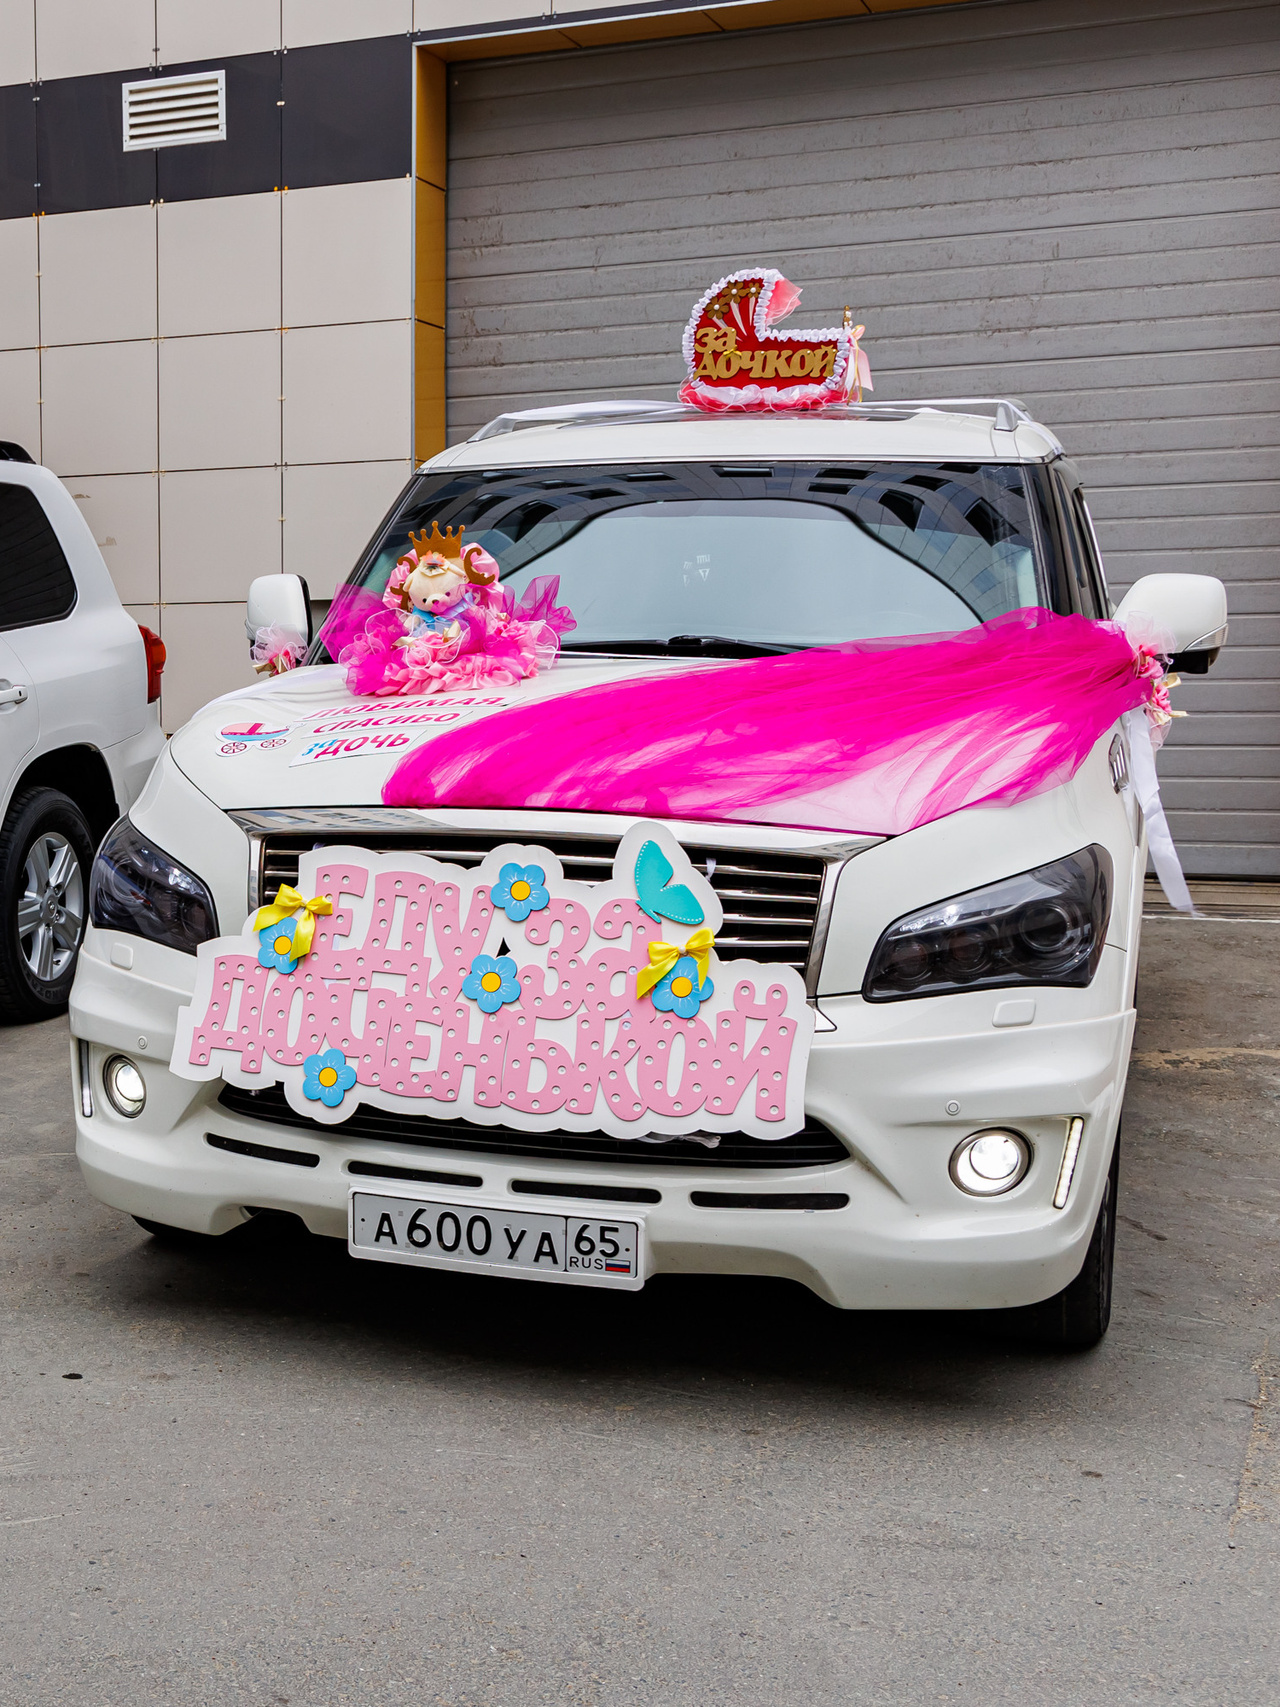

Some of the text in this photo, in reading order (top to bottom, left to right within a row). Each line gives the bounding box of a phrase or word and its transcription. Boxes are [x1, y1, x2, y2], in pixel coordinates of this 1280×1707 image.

[313, 712, 460, 734] СПАСИБО
[313, 733, 411, 760] ДОЧЬ
[308, 865, 496, 1002] ЕДУ
[188, 954, 799, 1123] ДОЧЕНЬКОЙ
[373, 1207, 620, 1265] А600УА 65
[569, 1256, 603, 1271] RUS
